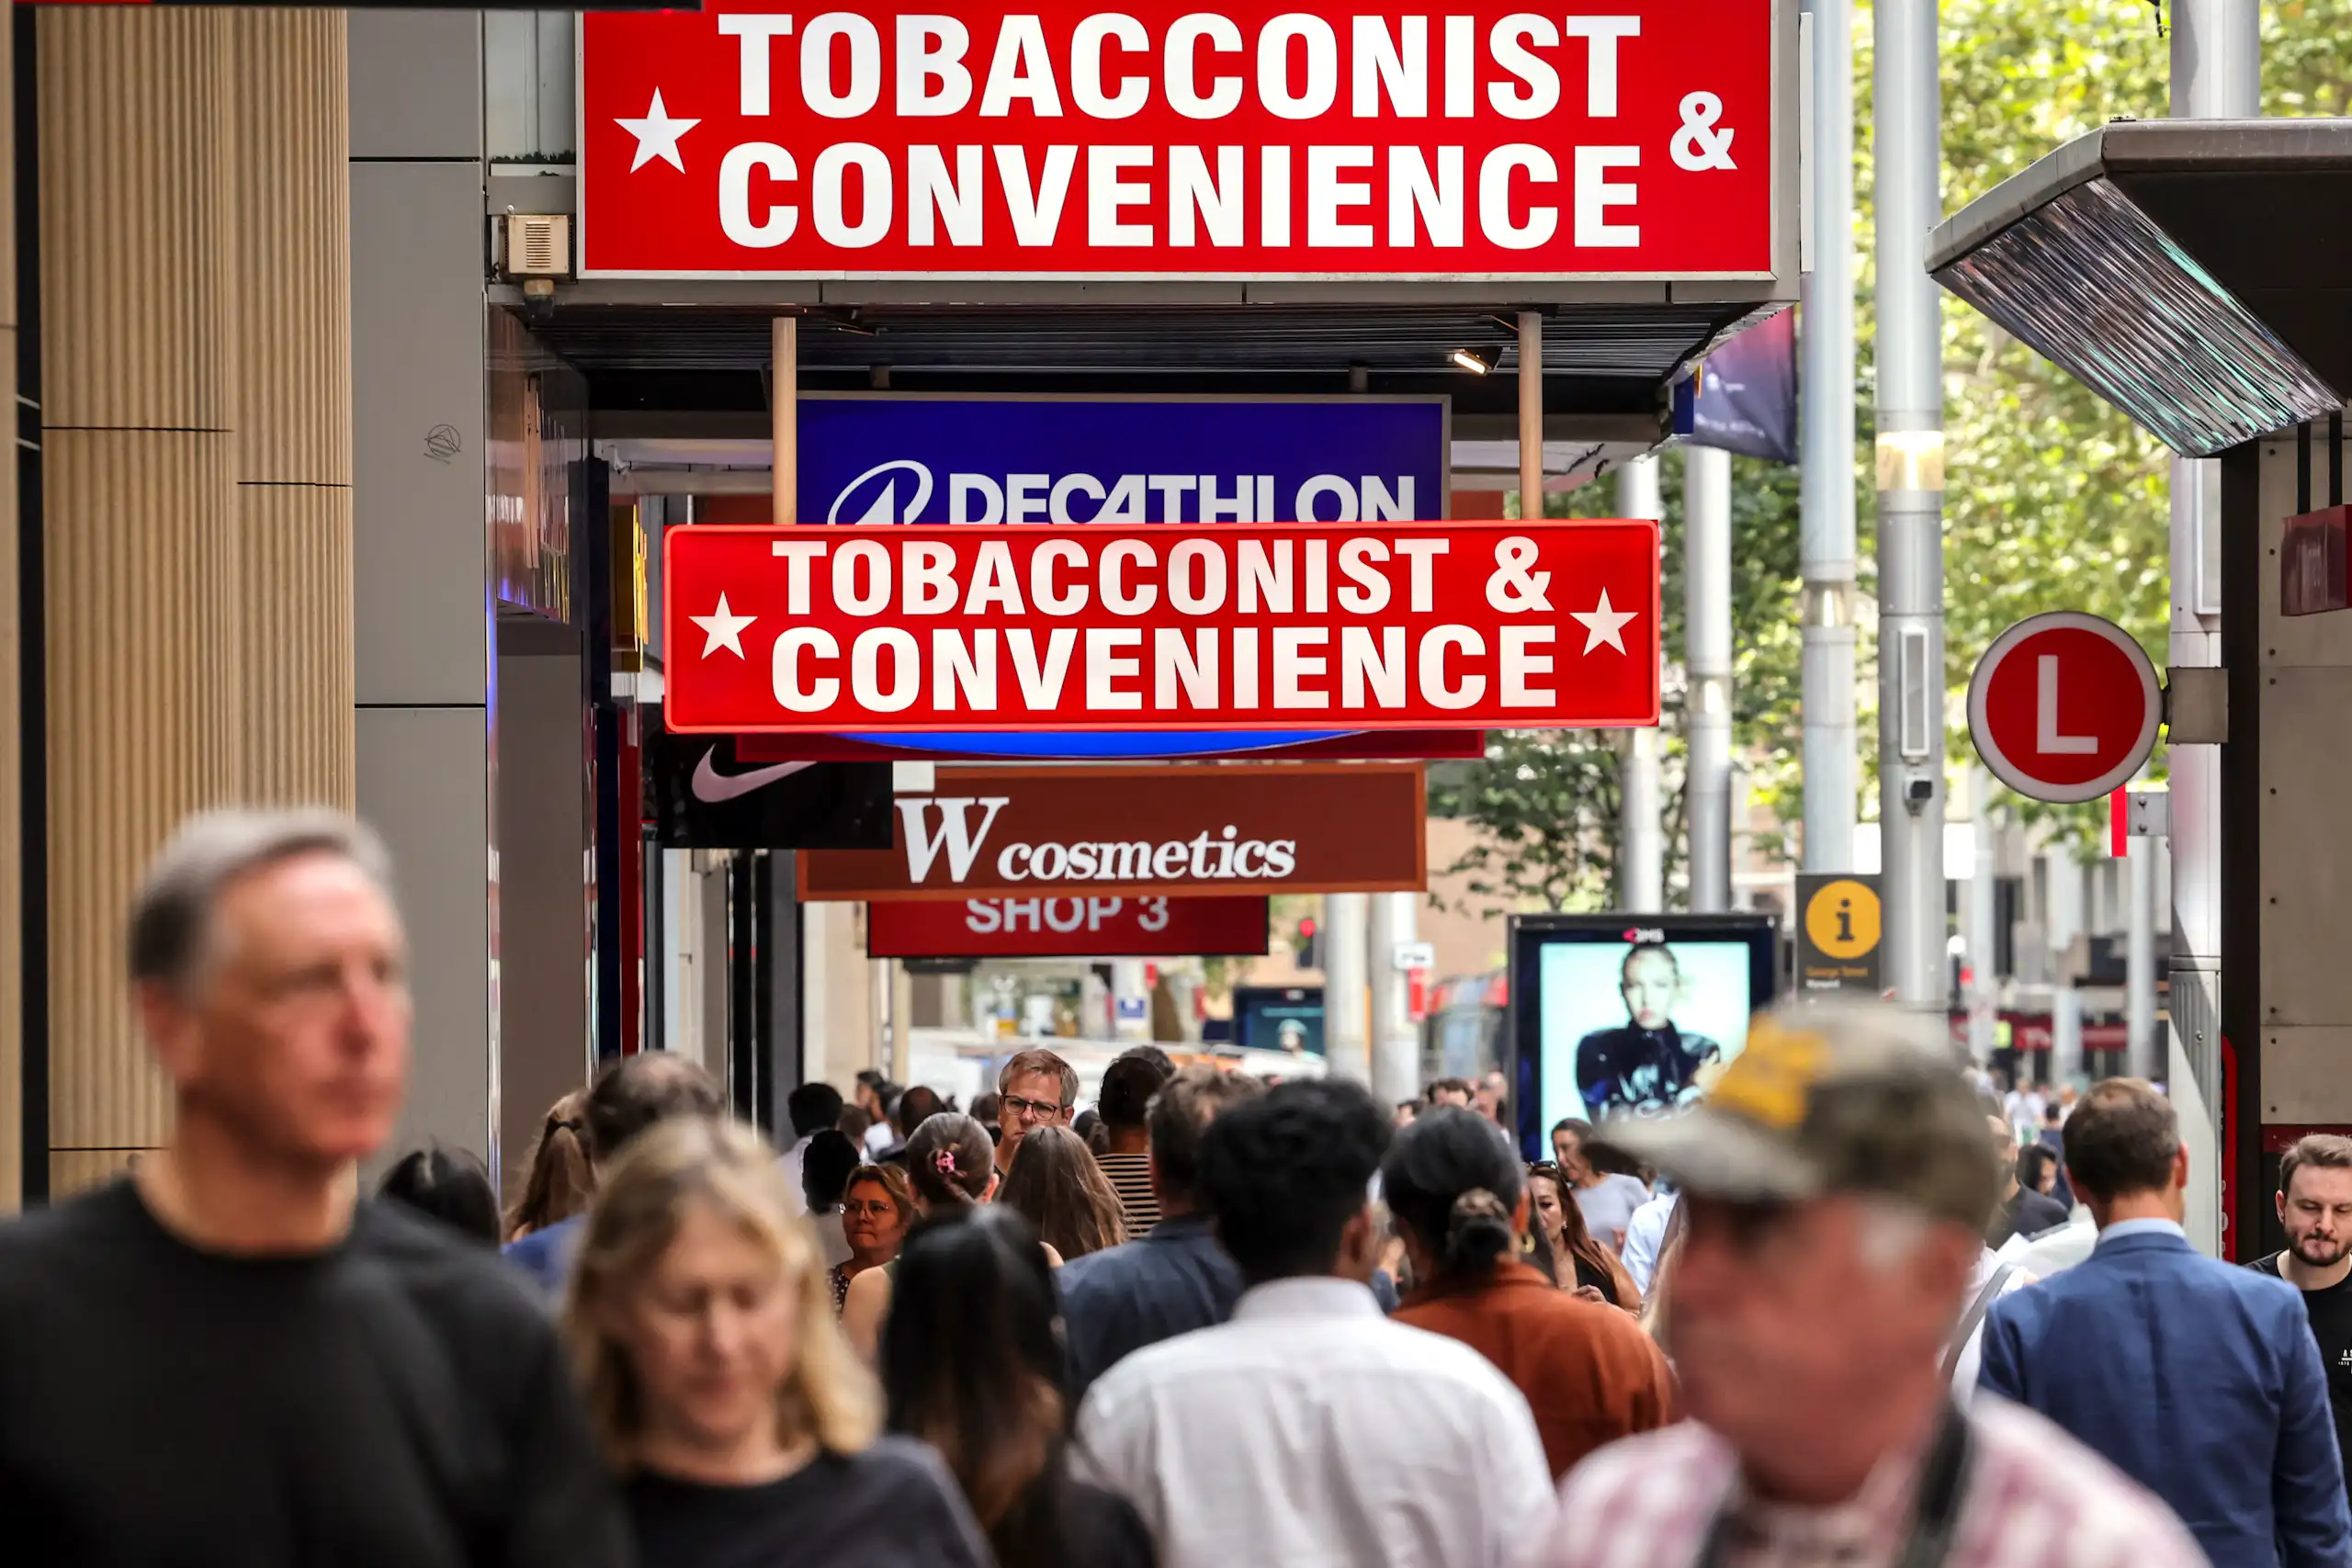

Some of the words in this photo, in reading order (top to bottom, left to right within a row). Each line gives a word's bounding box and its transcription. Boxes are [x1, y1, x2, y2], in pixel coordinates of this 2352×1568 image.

[718, 12, 1640, 119] TOBACCONIST
[1670, 91, 1737, 171] &
[719, 142, 1640, 249] CONVENIENCE
[772, 537, 1449, 616] TOBACCONIST
[1486, 536, 1555, 613] &
[772, 625, 1556, 713] CONVENIENCE
[2038, 655, 2098, 754] L
[894, 797, 1010, 883] W
[997, 825, 1295, 882] cosmetics
[966, 897, 1121, 932] SHOP
[1137, 897, 1169, 931] 3
